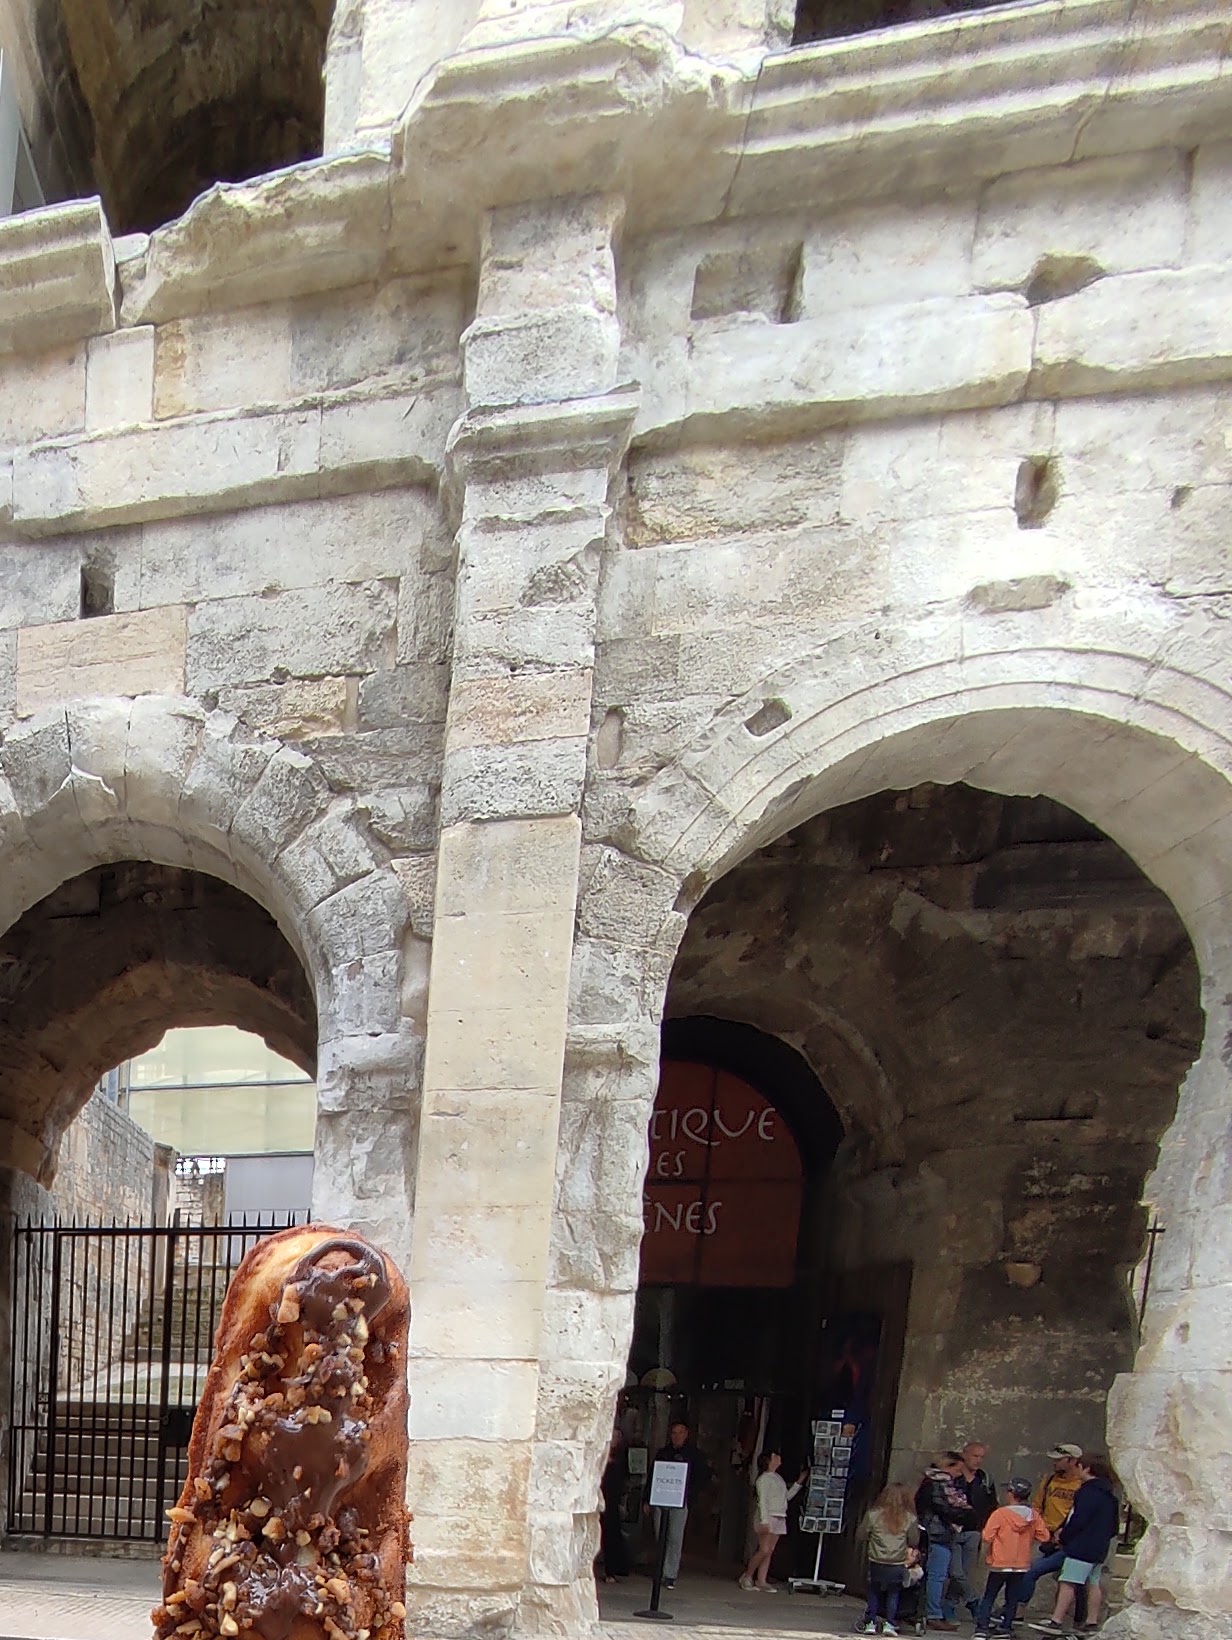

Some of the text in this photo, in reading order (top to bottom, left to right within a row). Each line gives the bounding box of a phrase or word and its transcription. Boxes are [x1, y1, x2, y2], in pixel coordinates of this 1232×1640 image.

[651, 1107, 776, 1146] TIQUE
[657, 1151, 686, 1176] ES
[643, 1192, 723, 1235] NES
[656, 1477, 683, 1485] TICKETS
